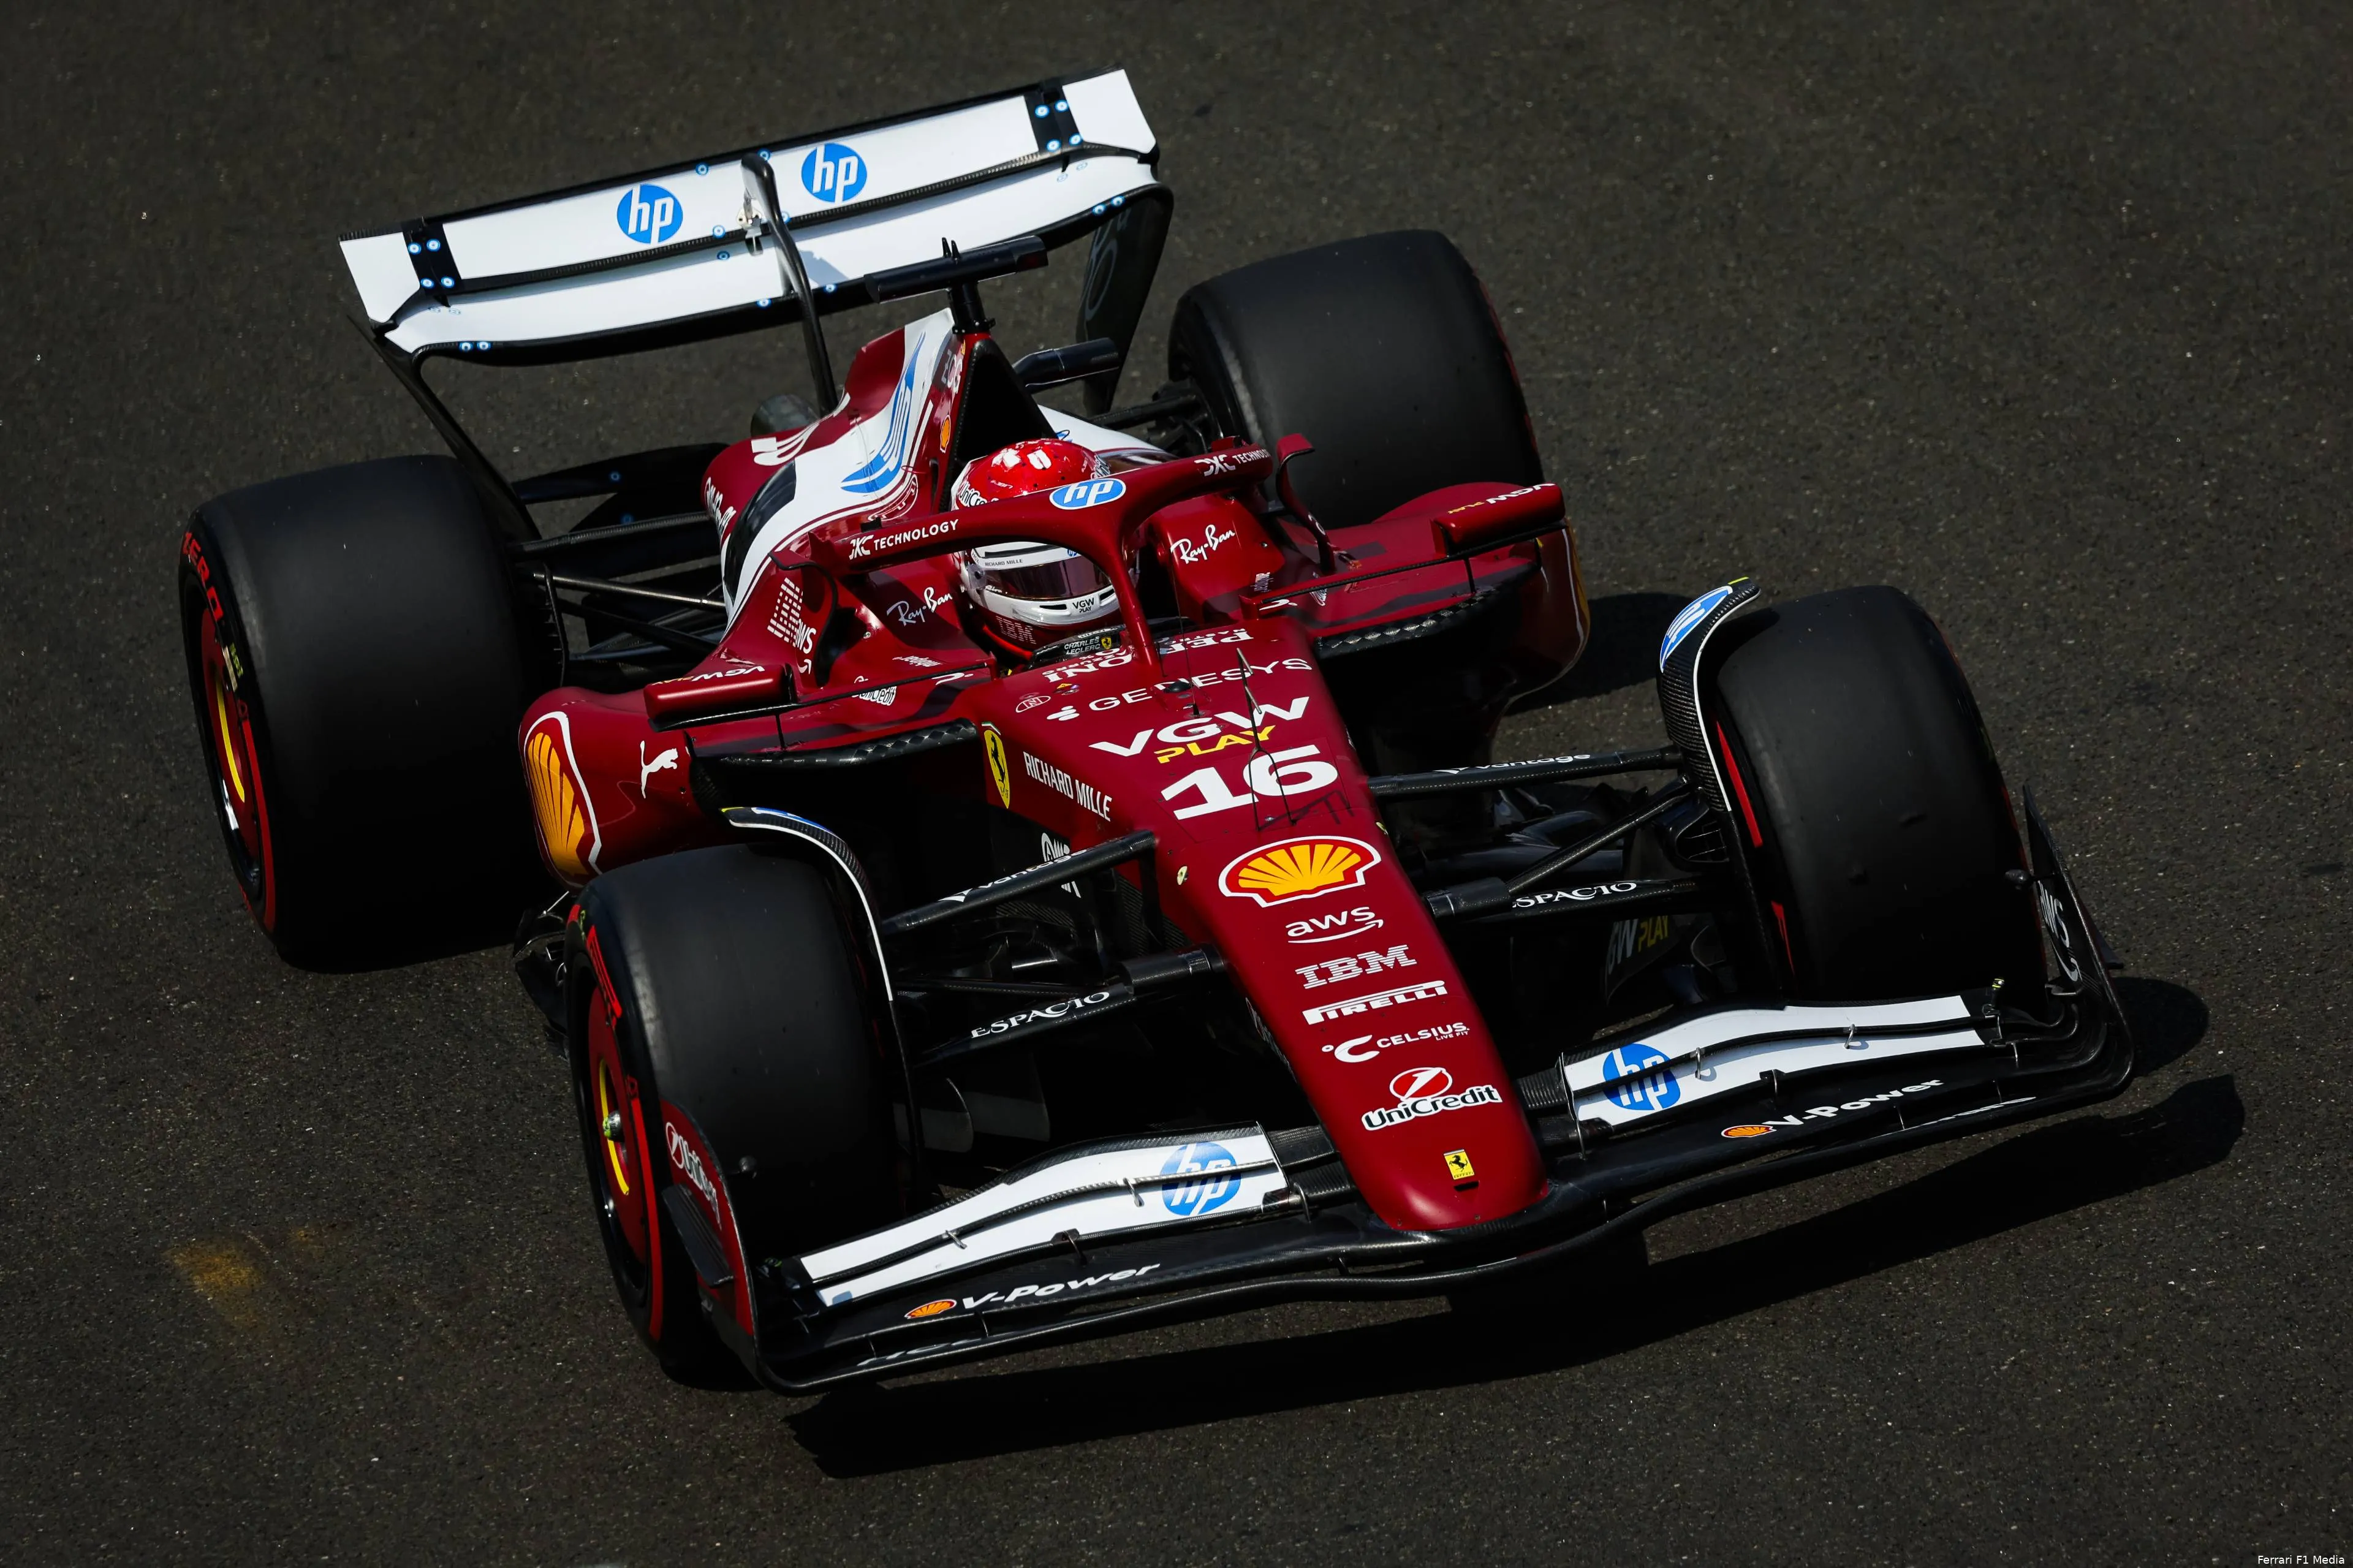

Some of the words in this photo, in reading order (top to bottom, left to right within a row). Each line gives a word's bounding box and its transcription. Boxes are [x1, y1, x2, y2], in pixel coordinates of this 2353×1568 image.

[811, 144, 859, 203] hp
[627, 184, 674, 244] hp
[1063, 480, 1115, 507] hp
[874, 519, 959, 551] TECHNOLOGY
[1072, 597, 1095, 609] VGW
[1064, 638, 1100, 650] CHARLES
[1066, 643, 1101, 655] LECLERC
[1089, 696, 1309, 757] VGW
[1154, 725, 1276, 763] PLAY
[1023, 750, 1074, 799] RICHARD
[1075, 779, 1113, 822] MILLE
[1161, 744, 1338, 820] 16
[1512, 881, 1637, 908] SPACIO
[1286, 906, 1376, 937] aws
[1295, 944, 1417, 990] IBM
[1302, 980, 1449, 1025] PIRELLI
[1376, 1021, 1468, 1049] CELSIUS
[1435, 1031, 1455, 1042] LIVE
[1456, 1029, 1469, 1039] FIT
[1363, 1084, 1501, 1130] UniCredit
[1767, 1078, 1944, 1127] V-Power
[963, 1262, 1161, 1311] V-Power
